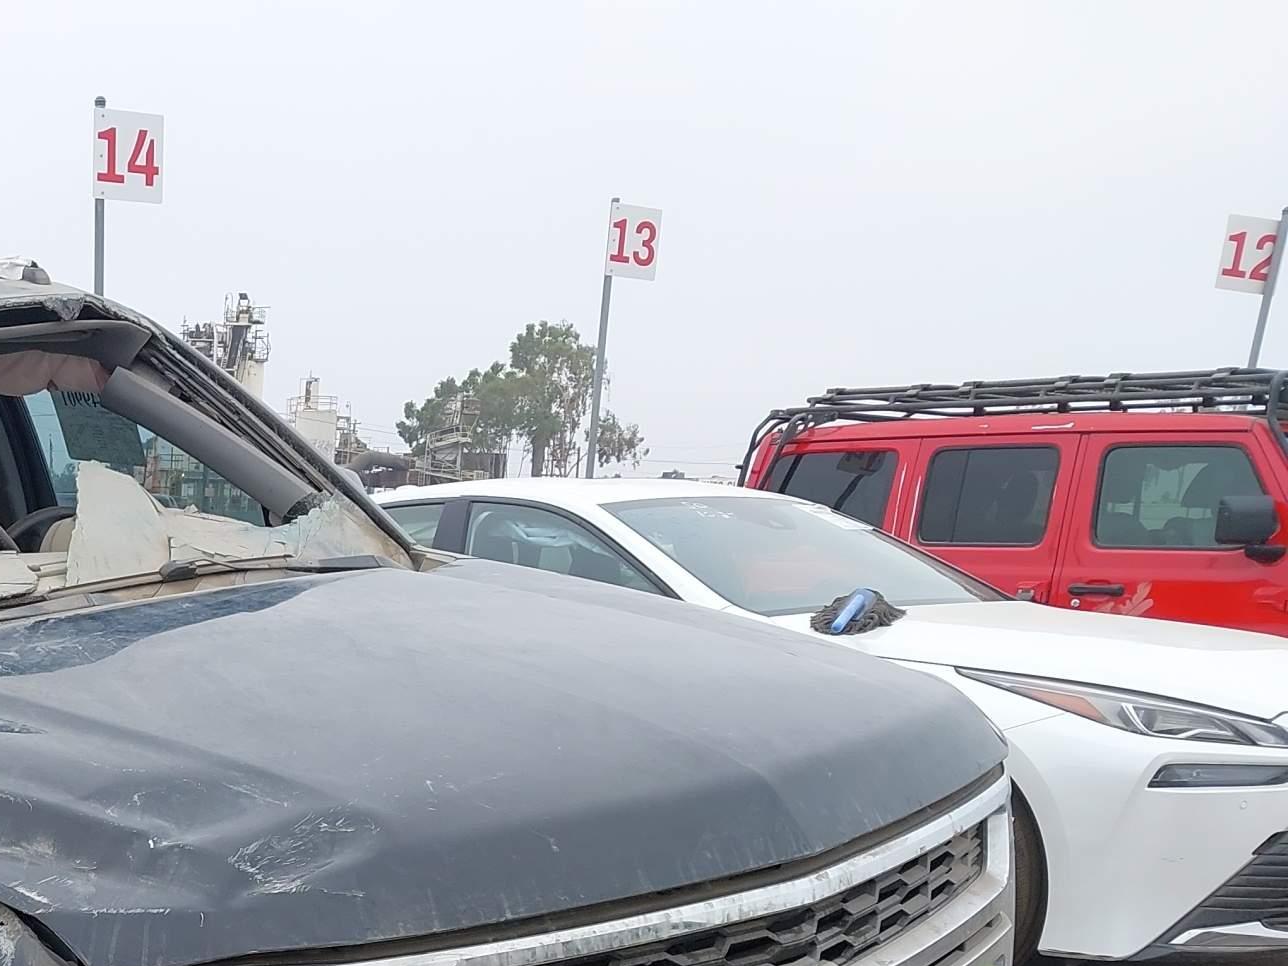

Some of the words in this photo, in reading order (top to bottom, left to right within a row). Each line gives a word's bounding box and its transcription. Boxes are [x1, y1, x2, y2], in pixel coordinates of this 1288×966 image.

[96, 127, 159, 187] 14
[610, 218, 657, 266] 13
[1221, 231, 1278, 282] 12
